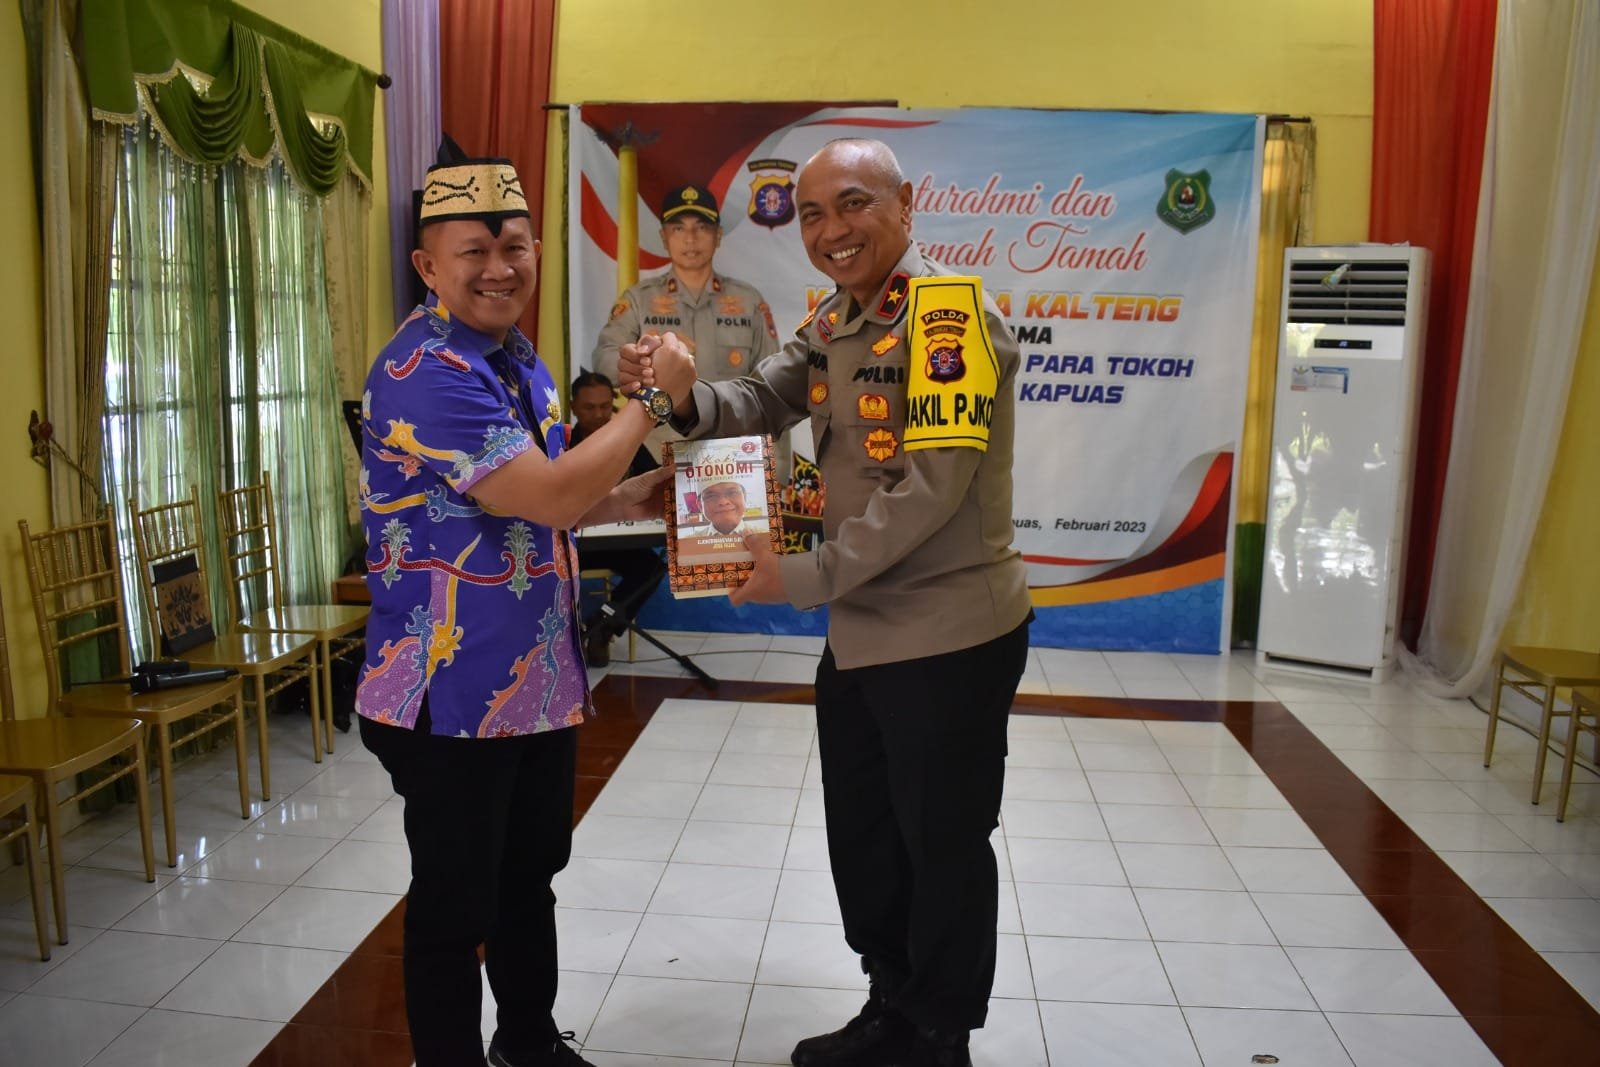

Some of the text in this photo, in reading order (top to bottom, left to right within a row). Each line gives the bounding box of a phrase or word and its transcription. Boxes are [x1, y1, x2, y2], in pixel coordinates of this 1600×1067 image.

[914, 175, 1114, 217] turahmi dan
[1008, 221, 1148, 274] Tamah
[924, 311, 965, 324] POLDA
[1025, 293, 1182, 323] KALTENG
[643, 316, 682, 326] AGUNG
[716, 318, 752, 327] POLRI
[1010, 325, 1052, 345] MA
[852, 366, 904, 385] POLRI
[1025, 355, 1195, 378] PARA TOKOH
[1019, 384, 1125, 405] KAPUAS
[685, 463, 753, 478] OTONOMI
[1012, 518, 1147, 534] uas, Februari 2023
